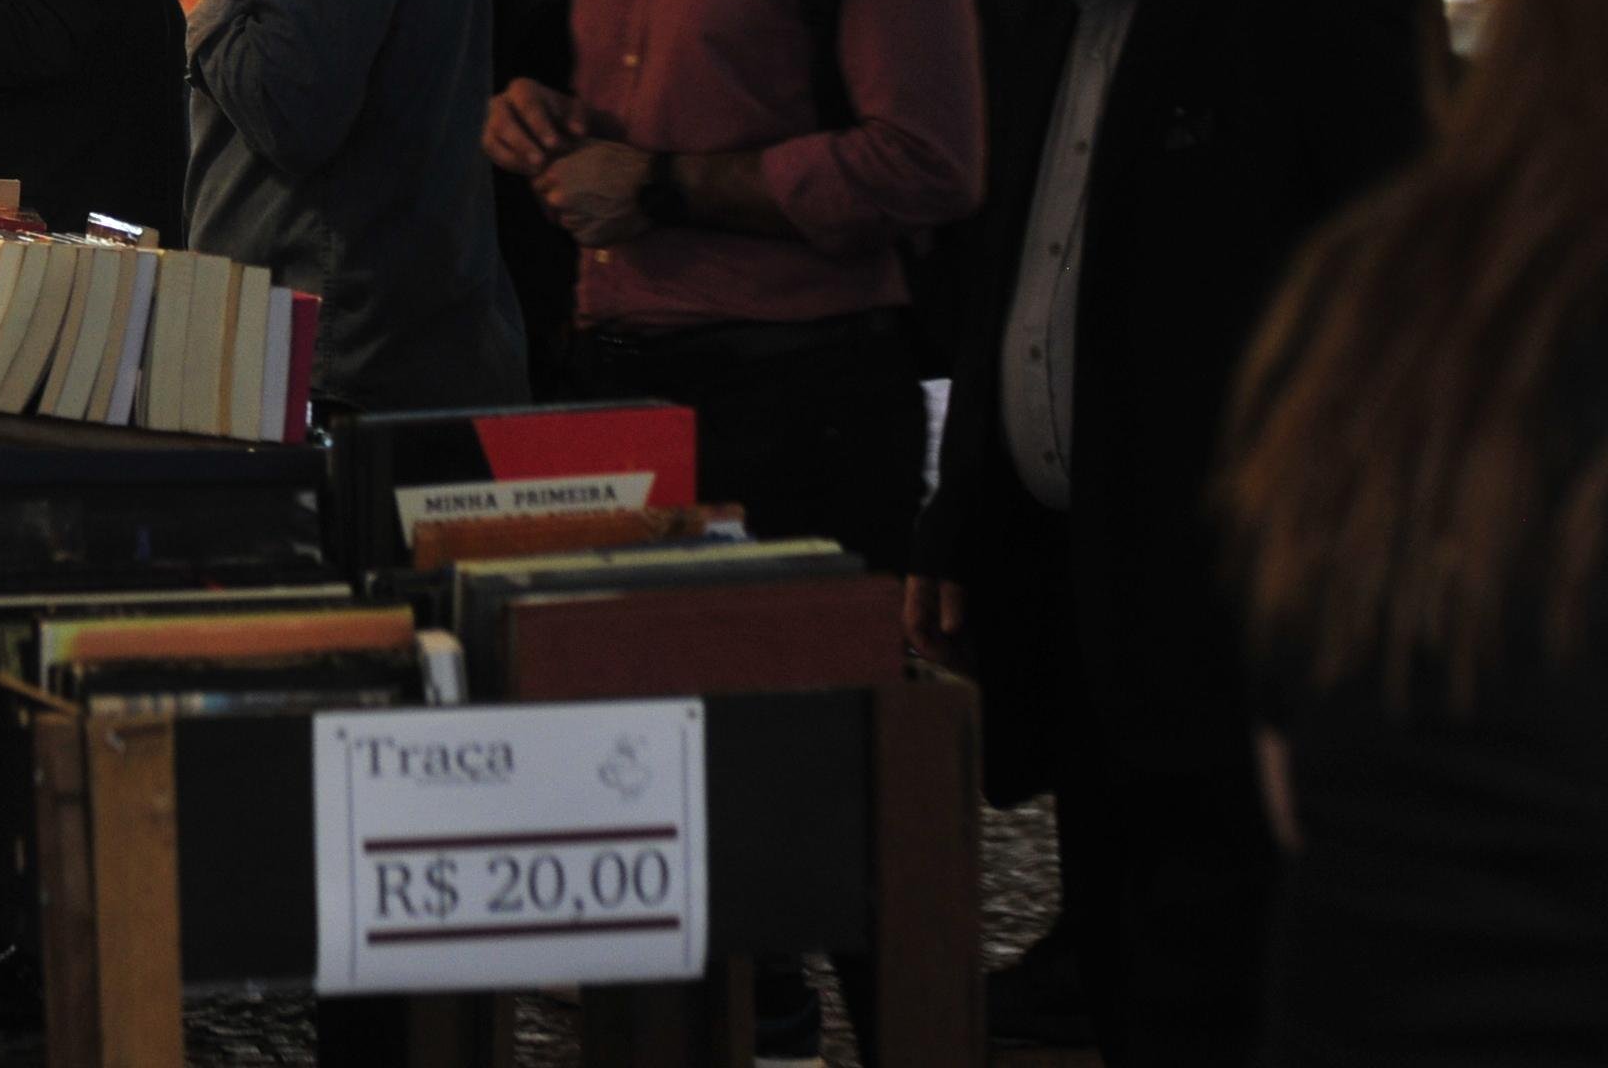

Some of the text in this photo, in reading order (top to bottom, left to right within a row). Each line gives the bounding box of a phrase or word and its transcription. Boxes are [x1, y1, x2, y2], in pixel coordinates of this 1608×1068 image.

[425, 484, 617, 513] MINHA PRIMEIRA
[356, 734, 514, 781] Traça
[374, 847, 671, 920] R$ 20,00
